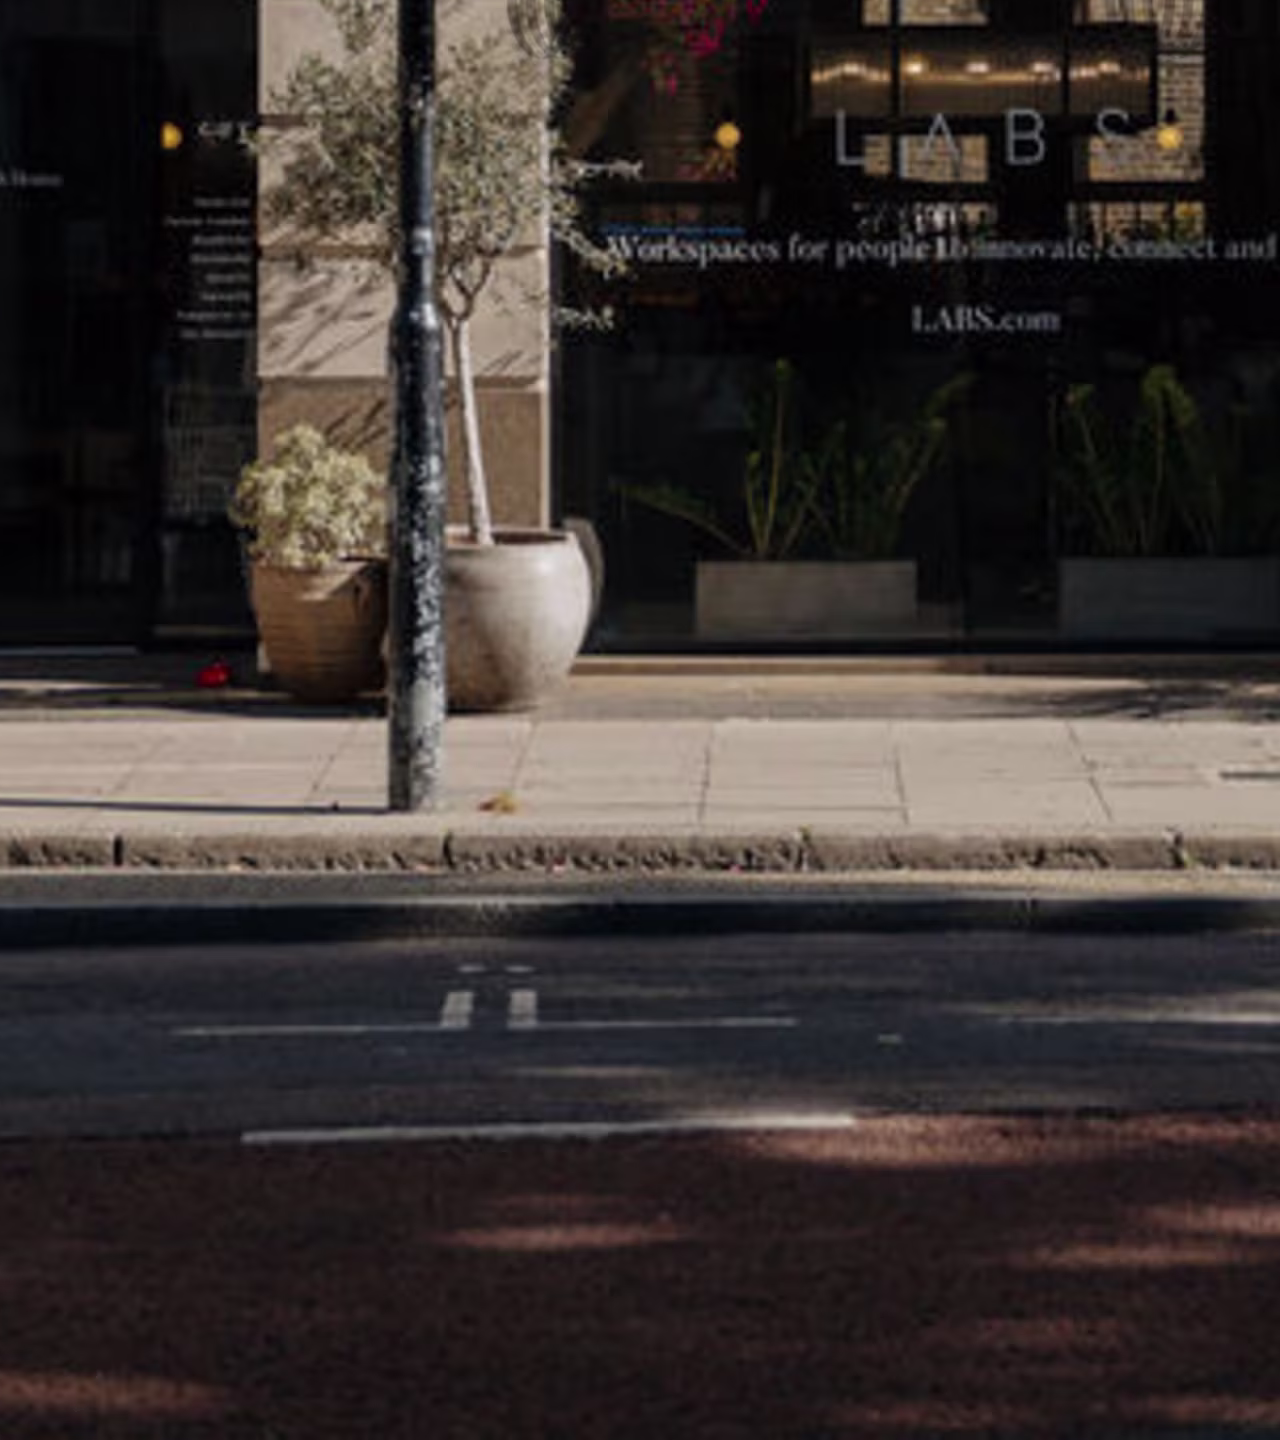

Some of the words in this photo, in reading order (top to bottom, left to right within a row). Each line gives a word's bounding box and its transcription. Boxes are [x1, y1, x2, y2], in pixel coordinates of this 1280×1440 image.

[835, 107, 1132, 167] LABS
[608, 234, 780, 269] Workspaces
[788, 232, 830, 262] for
[835, 232, 932, 269] people
[1224, 232, 1279, 261] and
[910, 303, 1062, 334] LABS.com
